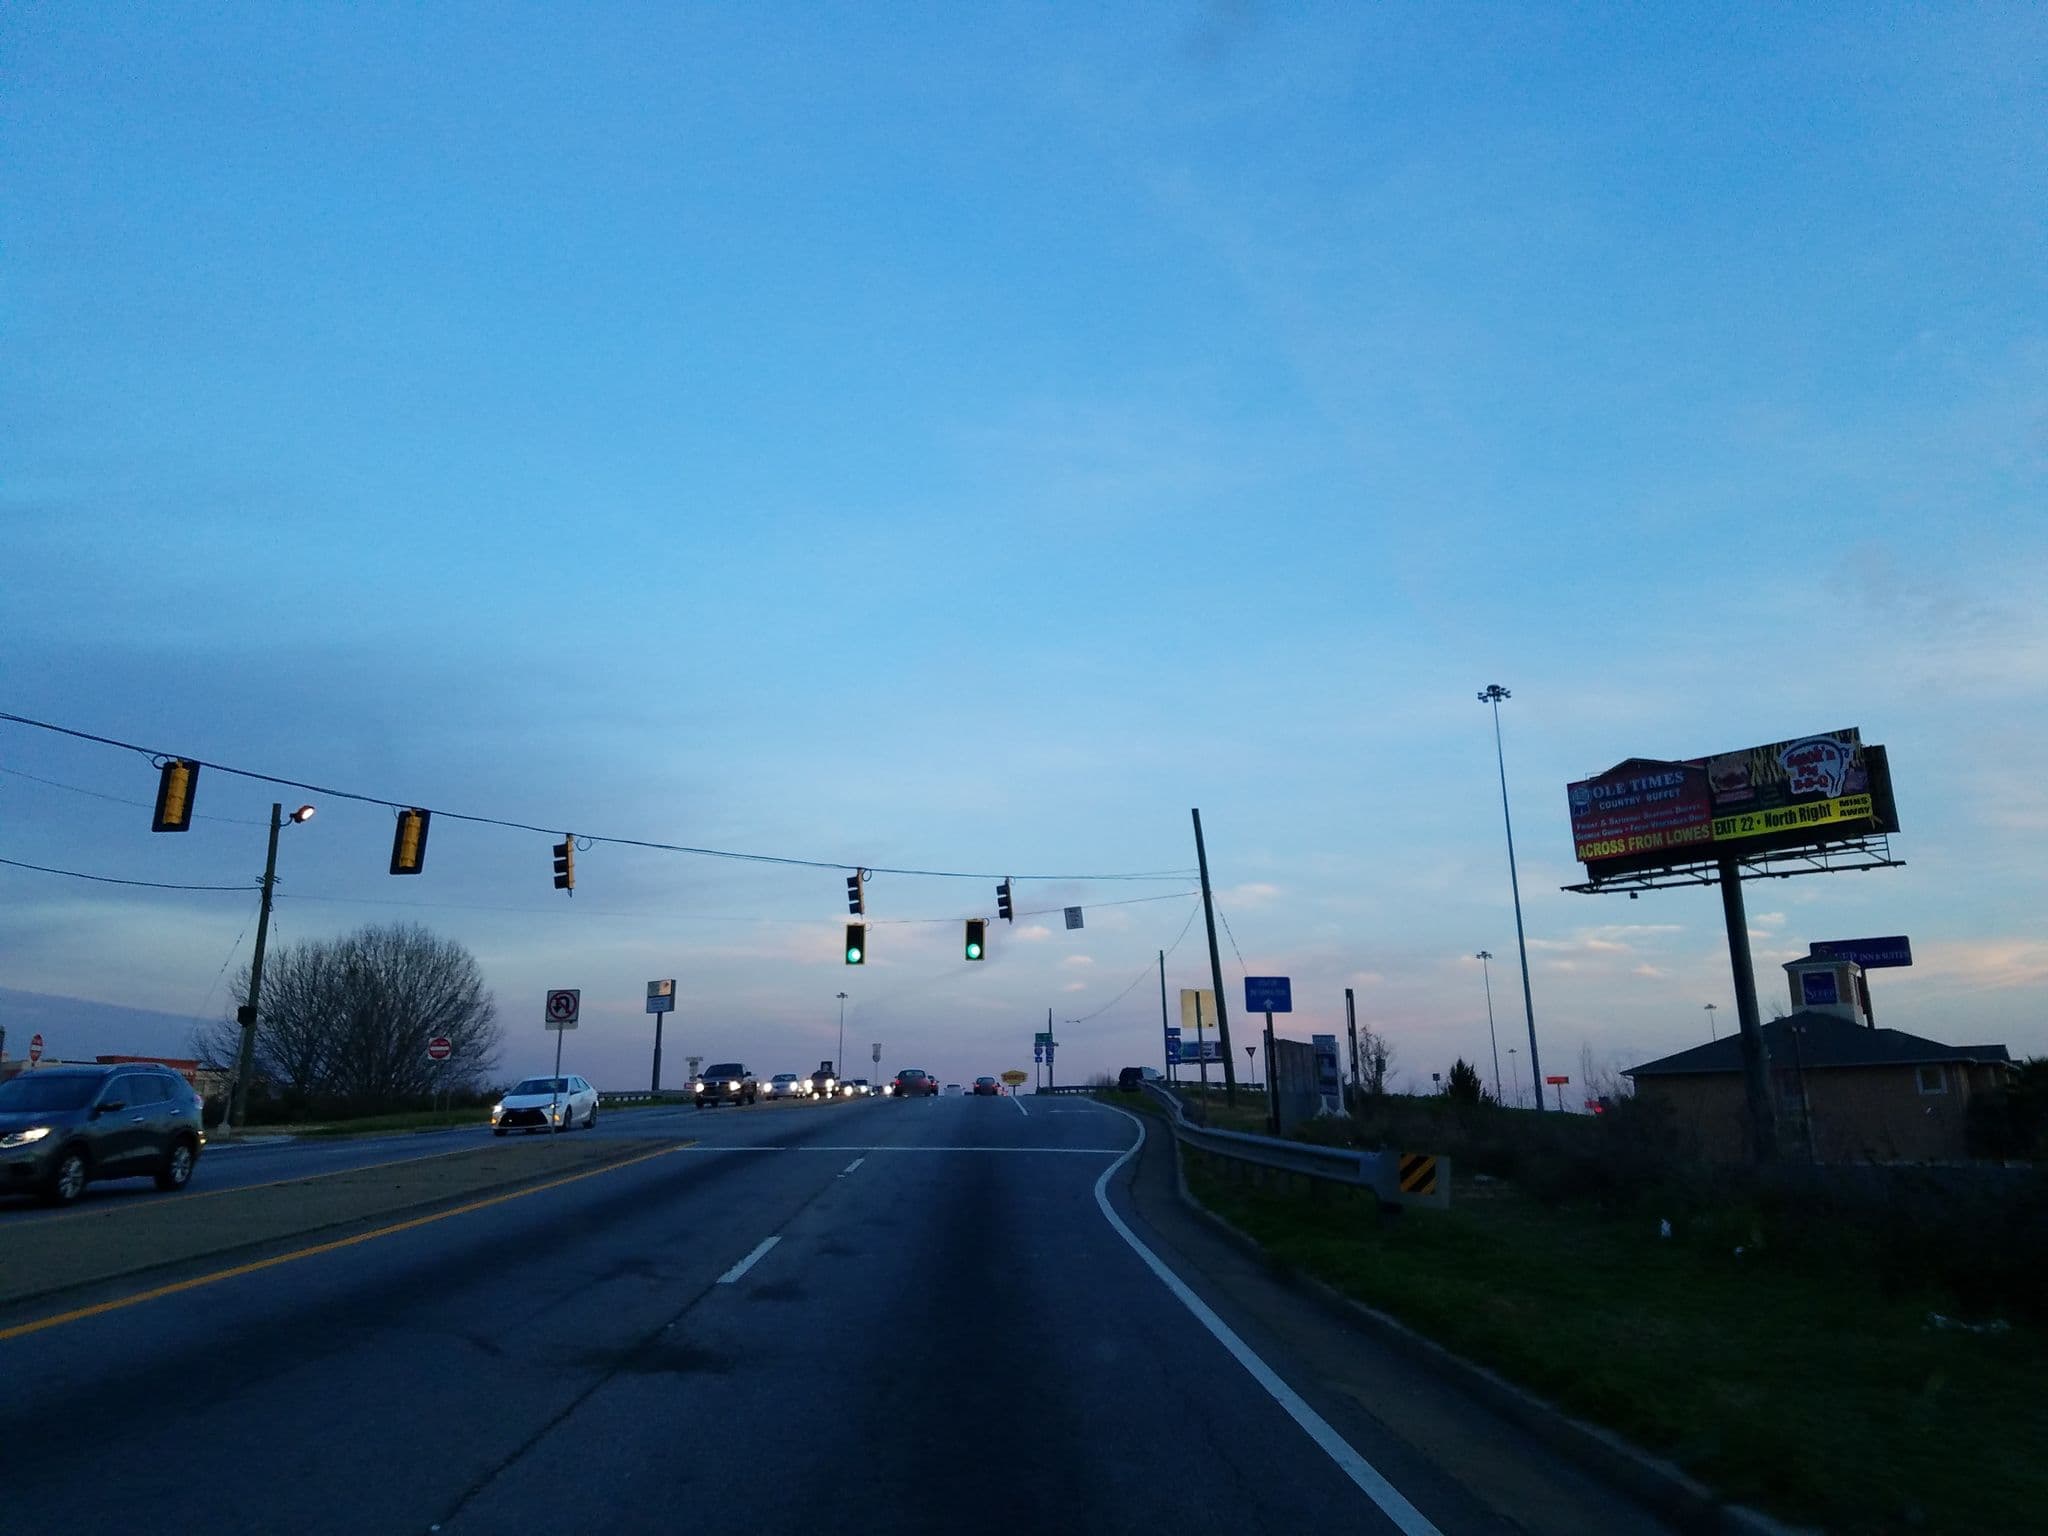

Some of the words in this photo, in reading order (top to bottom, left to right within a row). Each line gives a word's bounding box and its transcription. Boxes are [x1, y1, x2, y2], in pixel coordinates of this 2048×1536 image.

[1592, 782, 1626, 799] OLE
[1629, 771, 1686, 791] TIMES
[1599, 794, 1641, 810] COUNTRY
[1646, 787, 1681, 802] BUFFET
[1715, 818, 1737, 836] EXIT
[1741, 816, 1755, 832] 22
[1764, 808, 1797, 828] North
[1800, 803, 1832, 825] Right
[1578, 838, 1626, 859] ACROSS
[1628, 831, 1663, 852] FROM
[1667, 824, 1711, 845] LOWES
